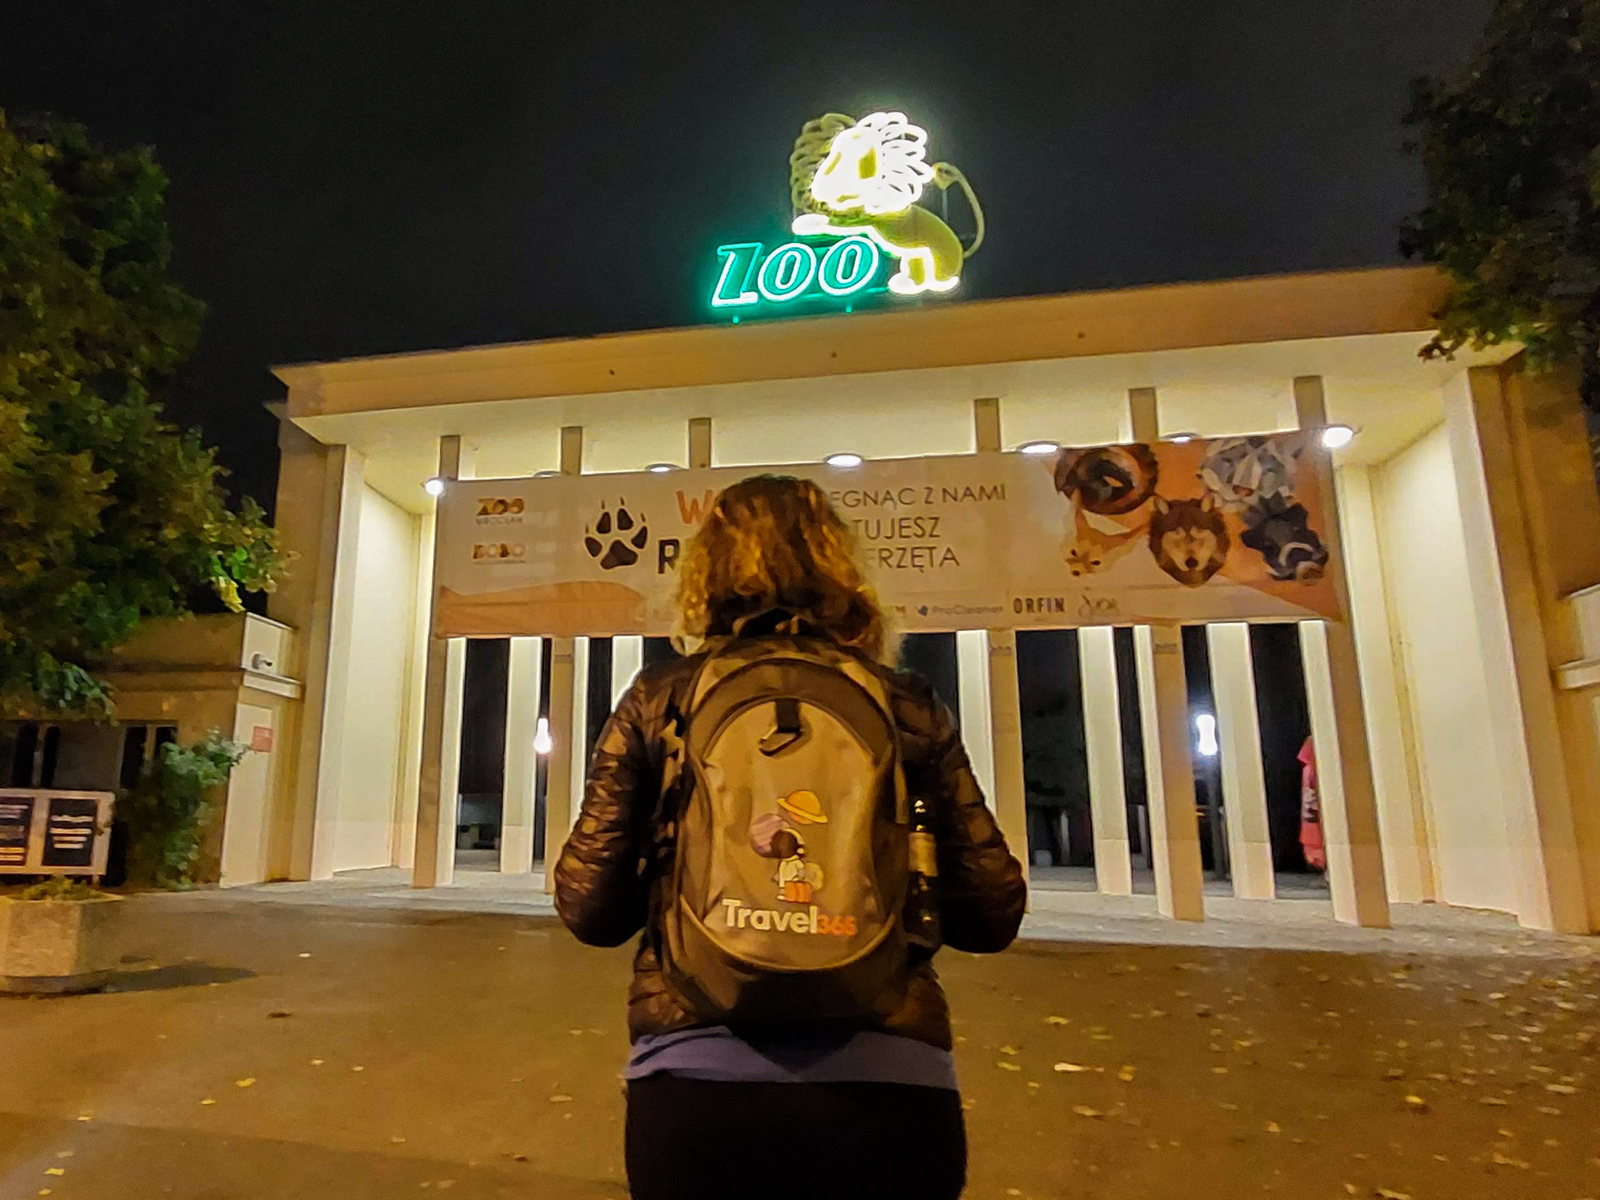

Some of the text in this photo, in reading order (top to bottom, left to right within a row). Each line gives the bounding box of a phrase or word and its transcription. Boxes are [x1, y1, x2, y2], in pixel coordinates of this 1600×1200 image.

[711, 235, 879, 308] ZOO
[476, 498, 524, 516] ZOO
[829, 483, 1006, 510] EGNĄC Z NAMI
[852, 516, 941, 540] TUJESZ
[862, 547, 960, 574] ERZĘTA
[1013, 597, 1065, 615] ORFIN
